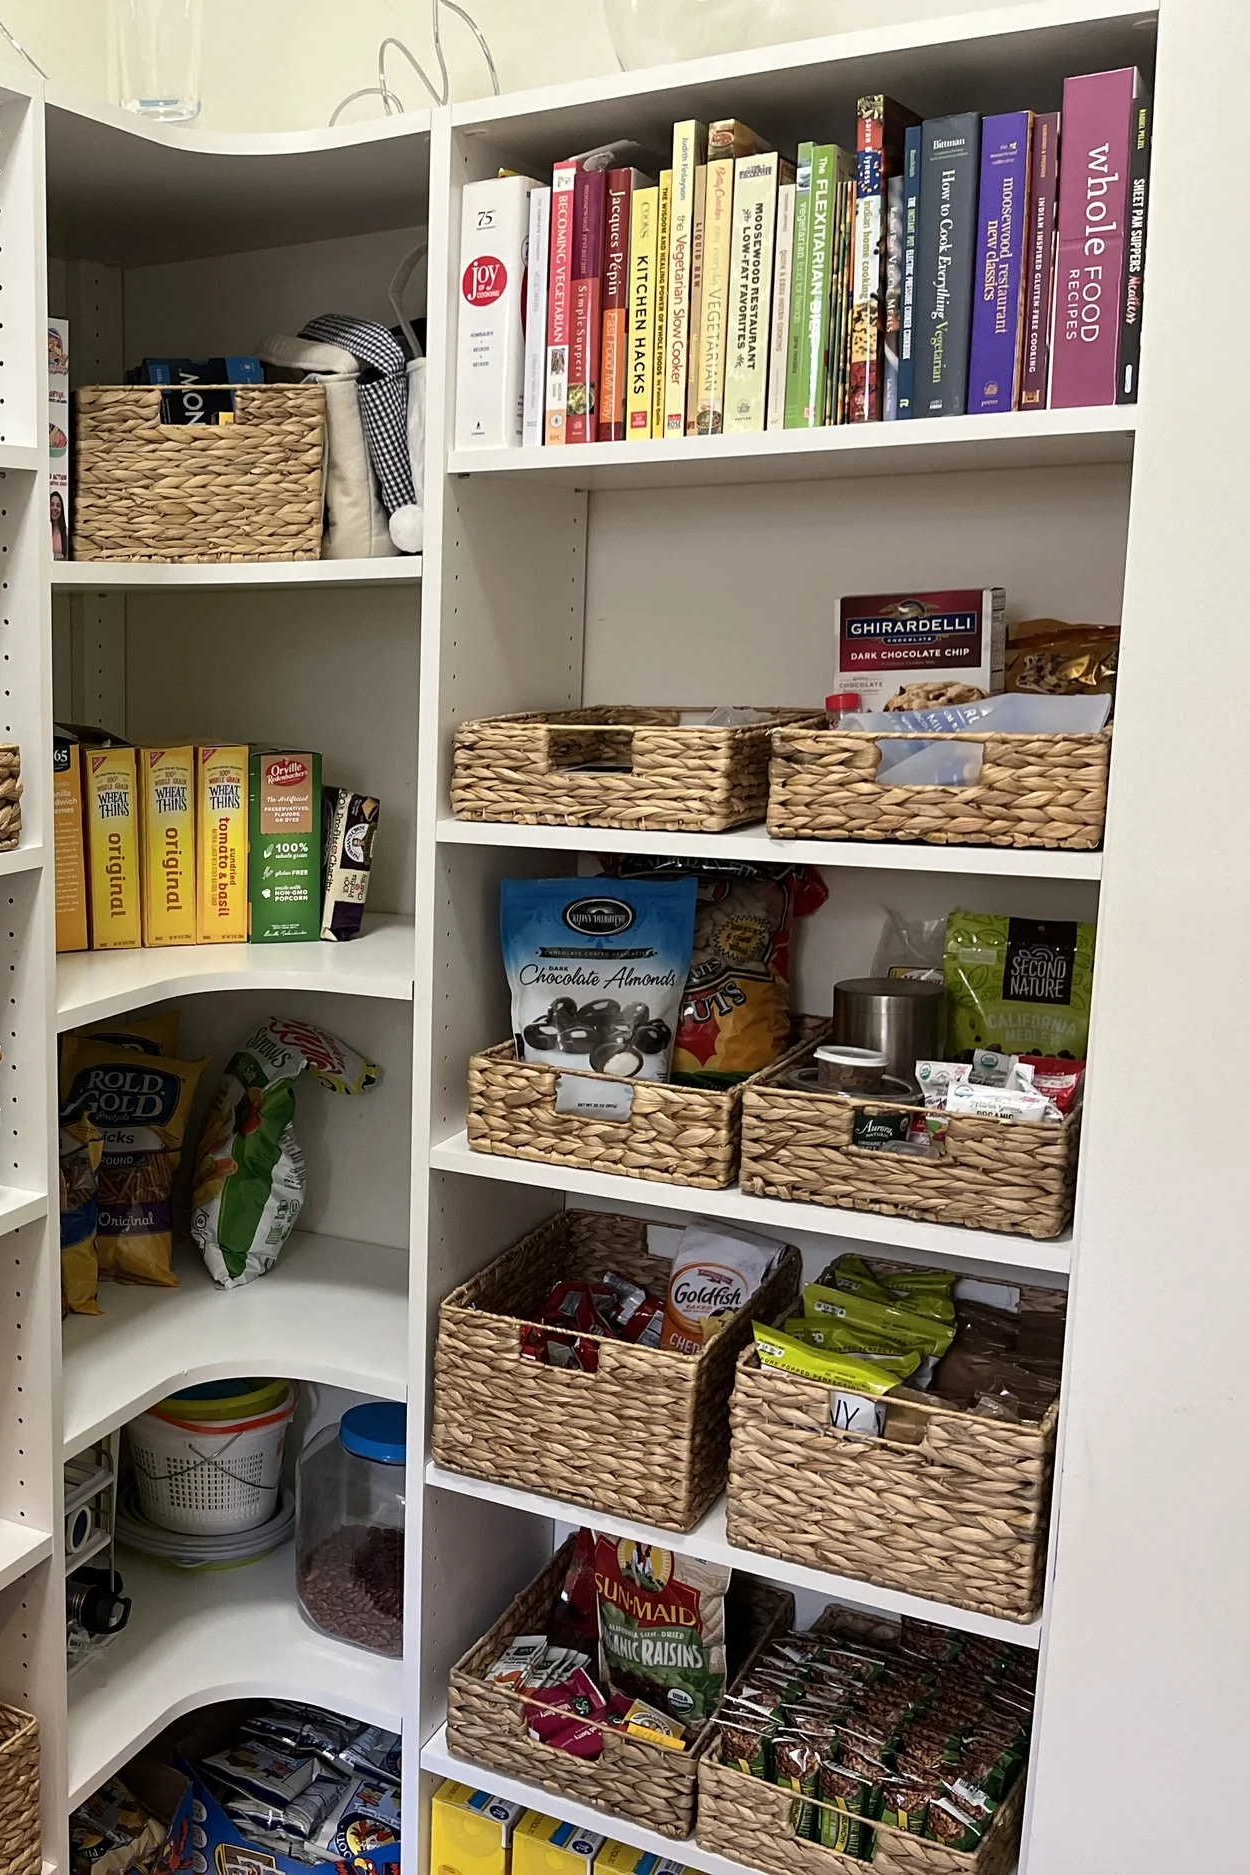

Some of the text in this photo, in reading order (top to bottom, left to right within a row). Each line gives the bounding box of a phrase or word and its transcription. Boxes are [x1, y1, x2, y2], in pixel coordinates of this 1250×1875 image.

[932, 138, 966, 151] Bittman
[608, 190, 626, 249] Jacques
[1129, 178, 1146, 273] SHEET PAN SUPPERS
[811, 178, 829, 294] FLEXITARIAN
[1035, 196, 1046, 272] INDIAN INSPIRED
[1080, 142, 1120, 343] whole FOOD
[995, 177, 1014, 335] moosewood restaurant
[552, 195, 568, 343] BECOMING VEGETARIAN
[930, 169, 956, 384] How Everything Vegetarian
[983, 250, 999, 302] classics
[737, 226, 751, 350] LOW-FAT FAVORITES
[746, 203, 764, 371] MOOSEWOOD RESTAURANT
[671, 233, 687, 386] Vegetarian Cooker
[1065, 268, 1081, 341] RECIPES
[633, 255, 649, 395] KITCHEN HACKS
[850, 617, 972, 635] GHIRARDELLI
[886, 636, 933, 644] CHOCOLATE
[850, 647, 970, 661] DARK CHOCOLATE CHIP
[265, 770, 309, 786] Redenbacher's
[271, 763, 303, 777] Orville
[97, 791, 130, 805] WHEAT
[155, 787, 188, 800] WHEAT
[208, 785, 241, 798] WHEAT
[209, 796, 241, 810] THINS
[98, 803, 130, 819] THINS
[155, 798, 188, 814] THINS
[275, 842, 309, 854] 100%
[105, 832, 127, 919] original
[162, 827, 183, 913] original
[218, 816, 231, 918] tomato & basil
[229, 847, 237, 887] sundried
[274, 889, 308, 897] NON-GMO
[274, 894, 309, 902] POPCORN
[519, 962, 677, 990] Chocolate Almonds
[1010, 957, 1067, 979] SECOND
[1009, 975, 1064, 999] NATURE
[986, 1011, 1077, 1038] CALIFORNIA
[1004, 1028, 1061, 1045] MEDLEY
[88, 1070, 165, 1093] ROLD
[59, 1090, 163, 1119] GOLD
[855, 1119, 894, 1136] Aurora
[865, 1130, 893, 1139] NATURAL
[98, 1209, 155, 1232] Original
[674, 1281, 741, 1306] Goldfish
[685, 1303, 713, 1311] BAKED
[780, 1362, 811, 1379] POPPED
[641, 1638, 704, 1669] RAISINS
